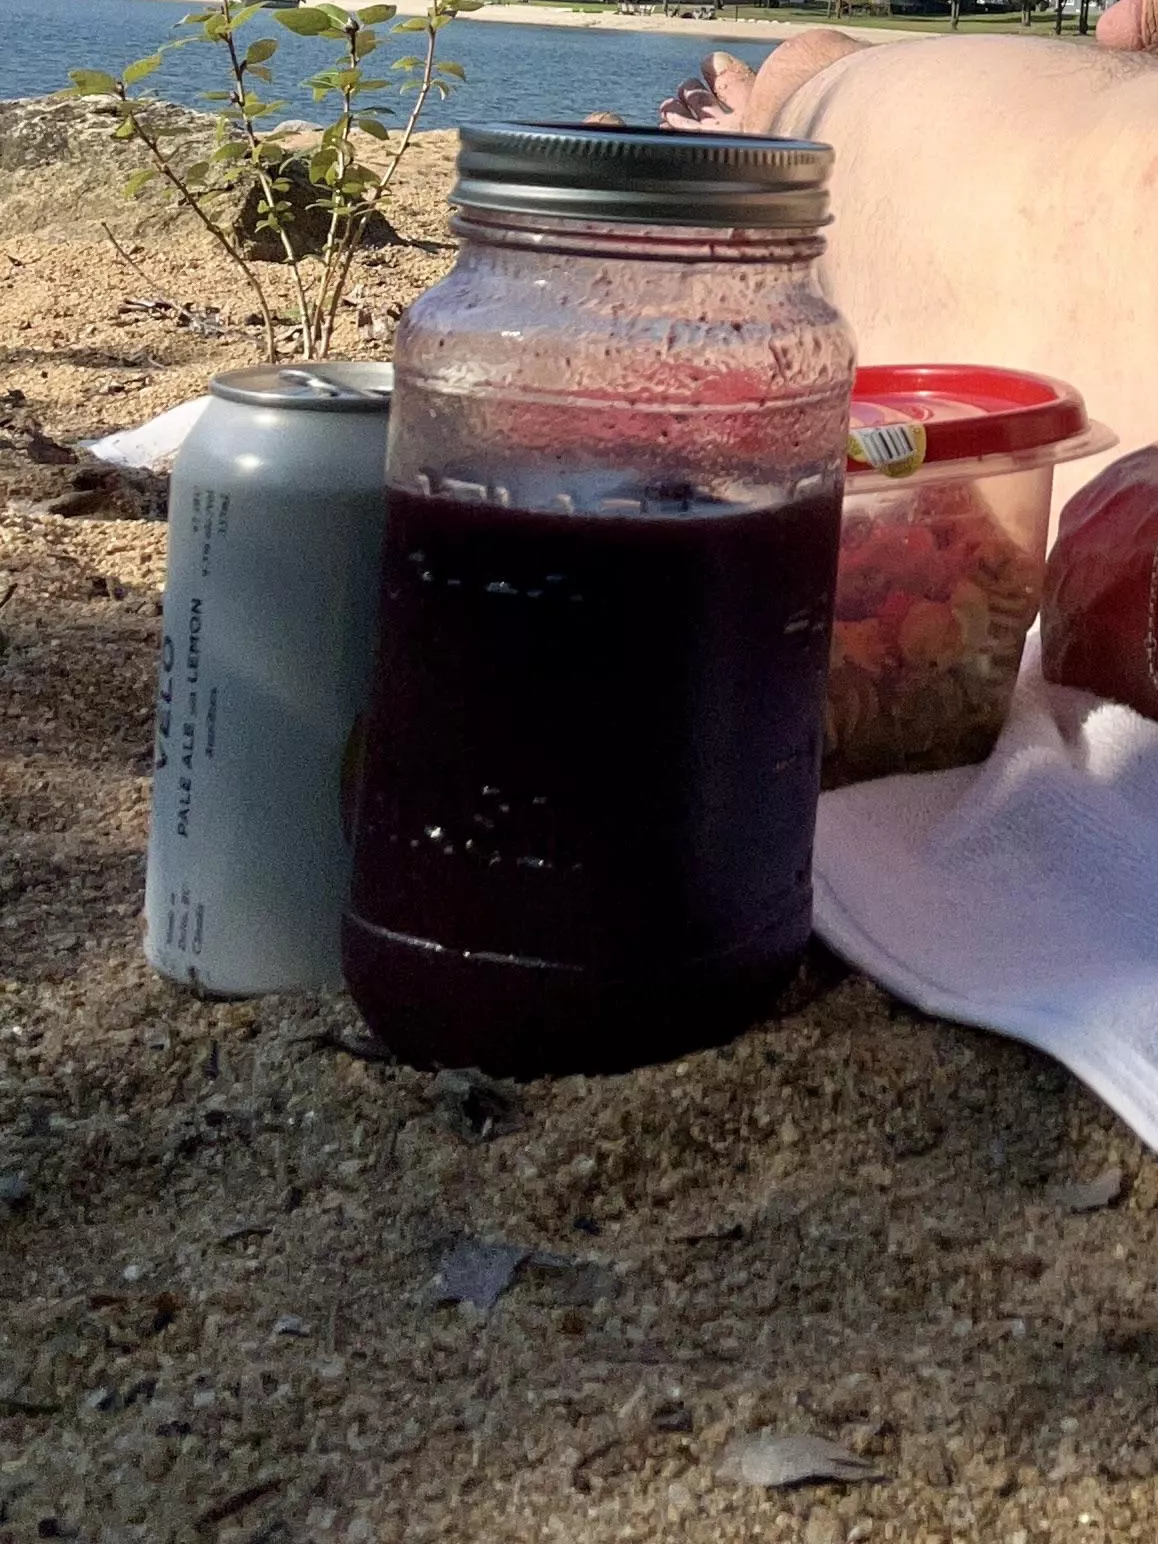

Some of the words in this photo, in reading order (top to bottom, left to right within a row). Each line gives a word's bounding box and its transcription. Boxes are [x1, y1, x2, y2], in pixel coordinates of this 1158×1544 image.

[186, 597, 203, 684] LEMON
[180, 722, 195, 771] ALE
[176, 775, 192, 839] PALE
